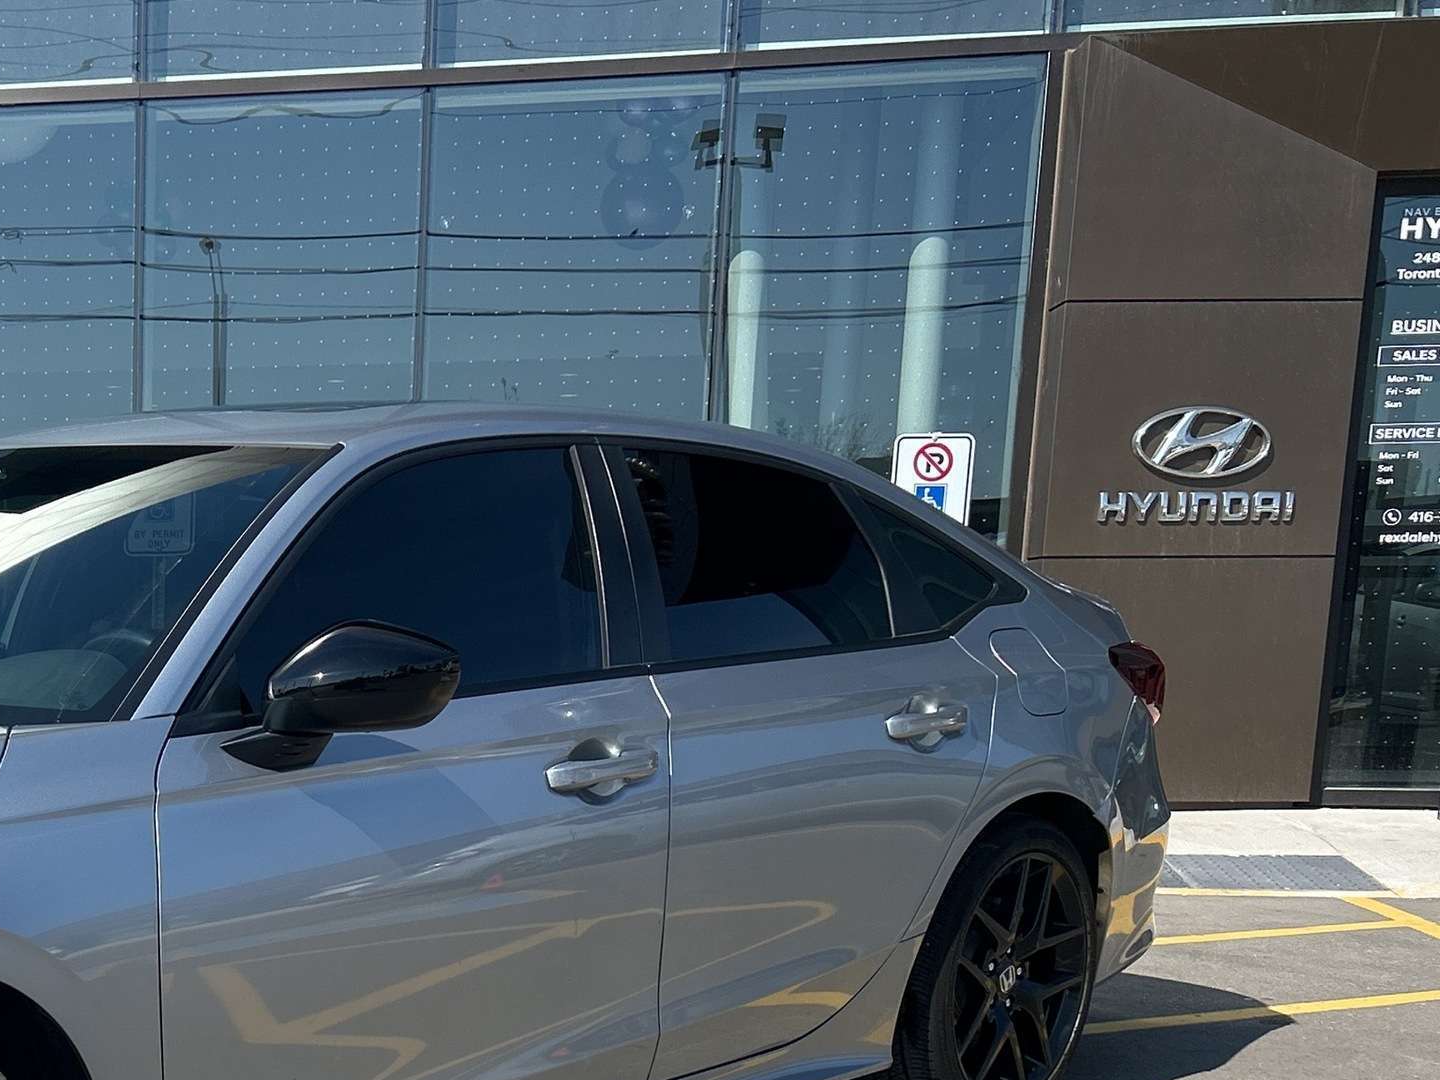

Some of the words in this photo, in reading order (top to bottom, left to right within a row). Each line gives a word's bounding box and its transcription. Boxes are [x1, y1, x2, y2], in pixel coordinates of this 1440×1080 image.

[1404, 208, 1430, 217] NAV
[1392, 350, 1437, 362] SALES
[1387, 374, 1408, 383] Mon
[1415, 374, 1433, 382] Thu
[1385, 387, 1399, 396] Fri
[1405, 387, 1422, 395] Sat
[1384, 400, 1402, 409] Sun
[1374, 428, 1436, 439] SERVICE
[1378, 452, 1400, 460] Mon
[1407, 451, 1419, 459] Fri
[1377, 464, 1394, 473] Sat
[1375, 477, 1394, 485] Sun
[1097, 490, 1295, 524] HYUNDAI
[1408, 511, 1440, 523] 416-
